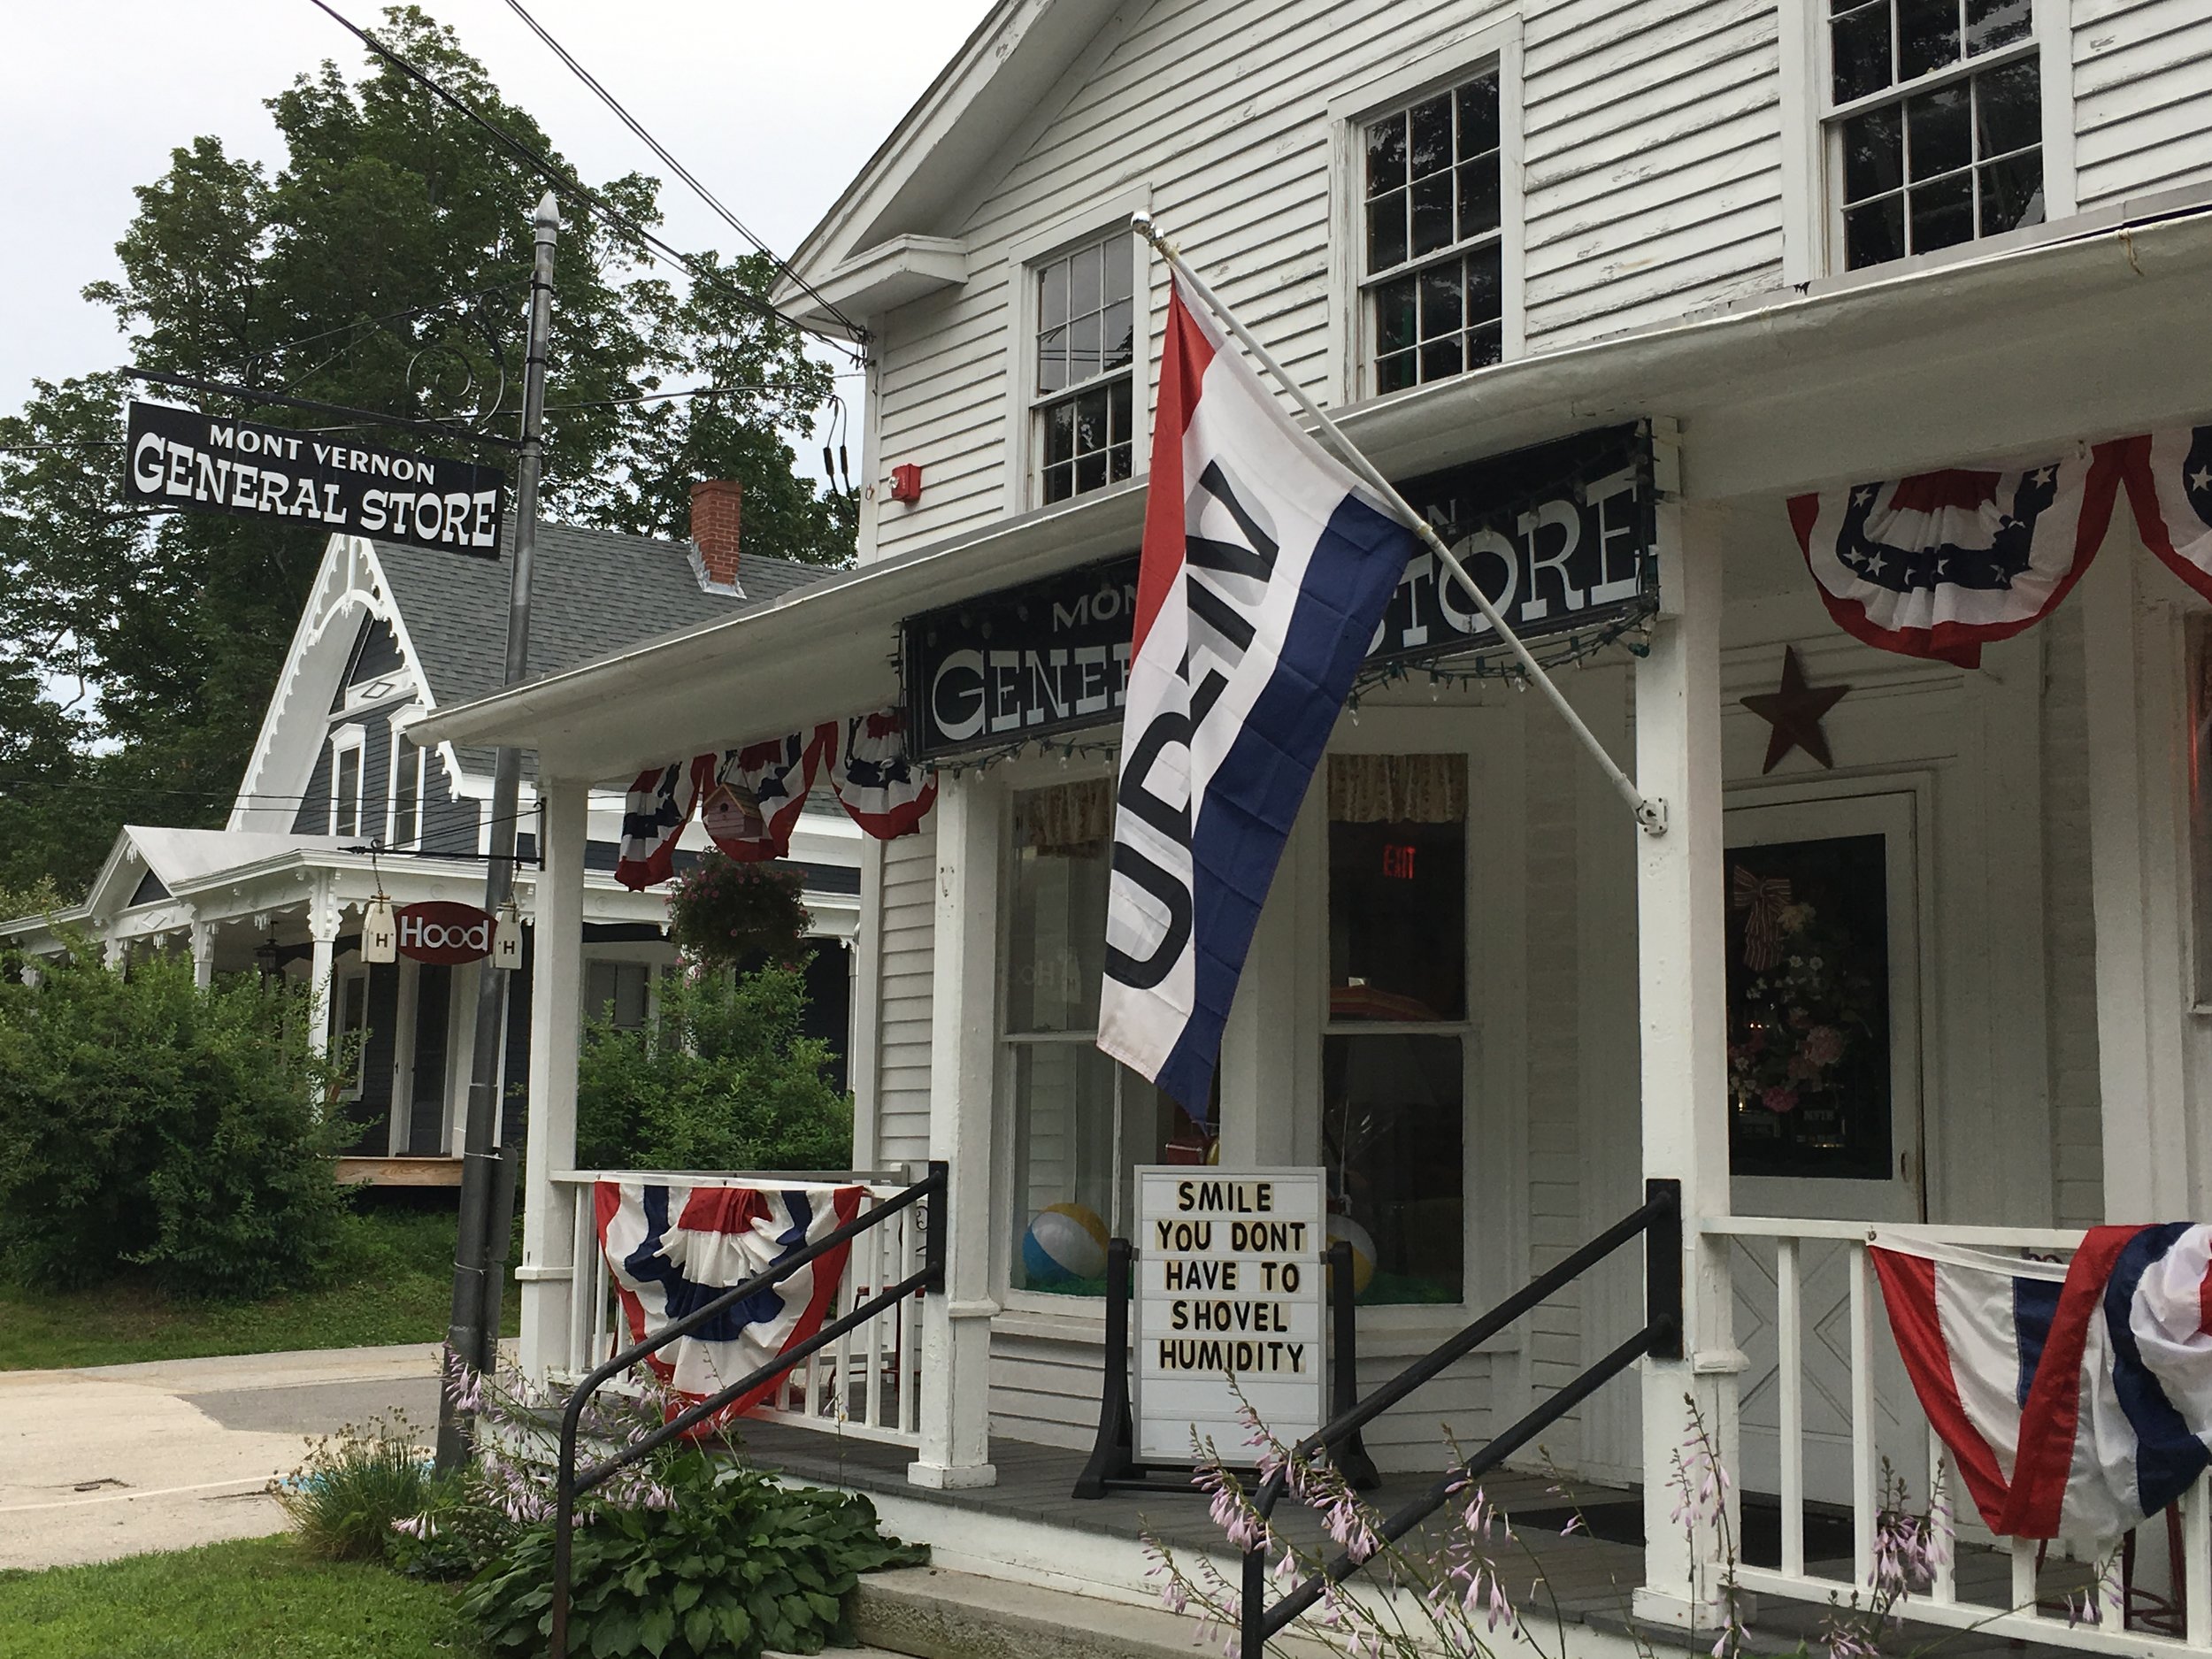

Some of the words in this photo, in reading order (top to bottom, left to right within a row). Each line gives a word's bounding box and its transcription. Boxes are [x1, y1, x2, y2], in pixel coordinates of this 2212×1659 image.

[210, 424, 303, 460] MONT
[312, 443, 435, 486] VERNON
[133, 432, 347, 524] GENERAL
[360, 488, 497, 548] STORE
[1364, 465, 1643, 658] TORE
[1383, 844, 1416, 879] EXIT
[376, 933, 388, 948] H
[400, 915, 488, 951] Hood
[503, 941, 515, 955] H
[1179, 1181, 1271, 1213] SMILE
[1157, 1220, 1211, 1252] YOU
[1232, 1222, 1306, 1252] DONT
[1166, 1261, 1236, 1291] HAVE
[1261, 1261, 1300, 1293] TO
[1171, 1301, 1287, 1333] SHOVEL
[1160, 1340, 1304, 1372] HUMIDITY
